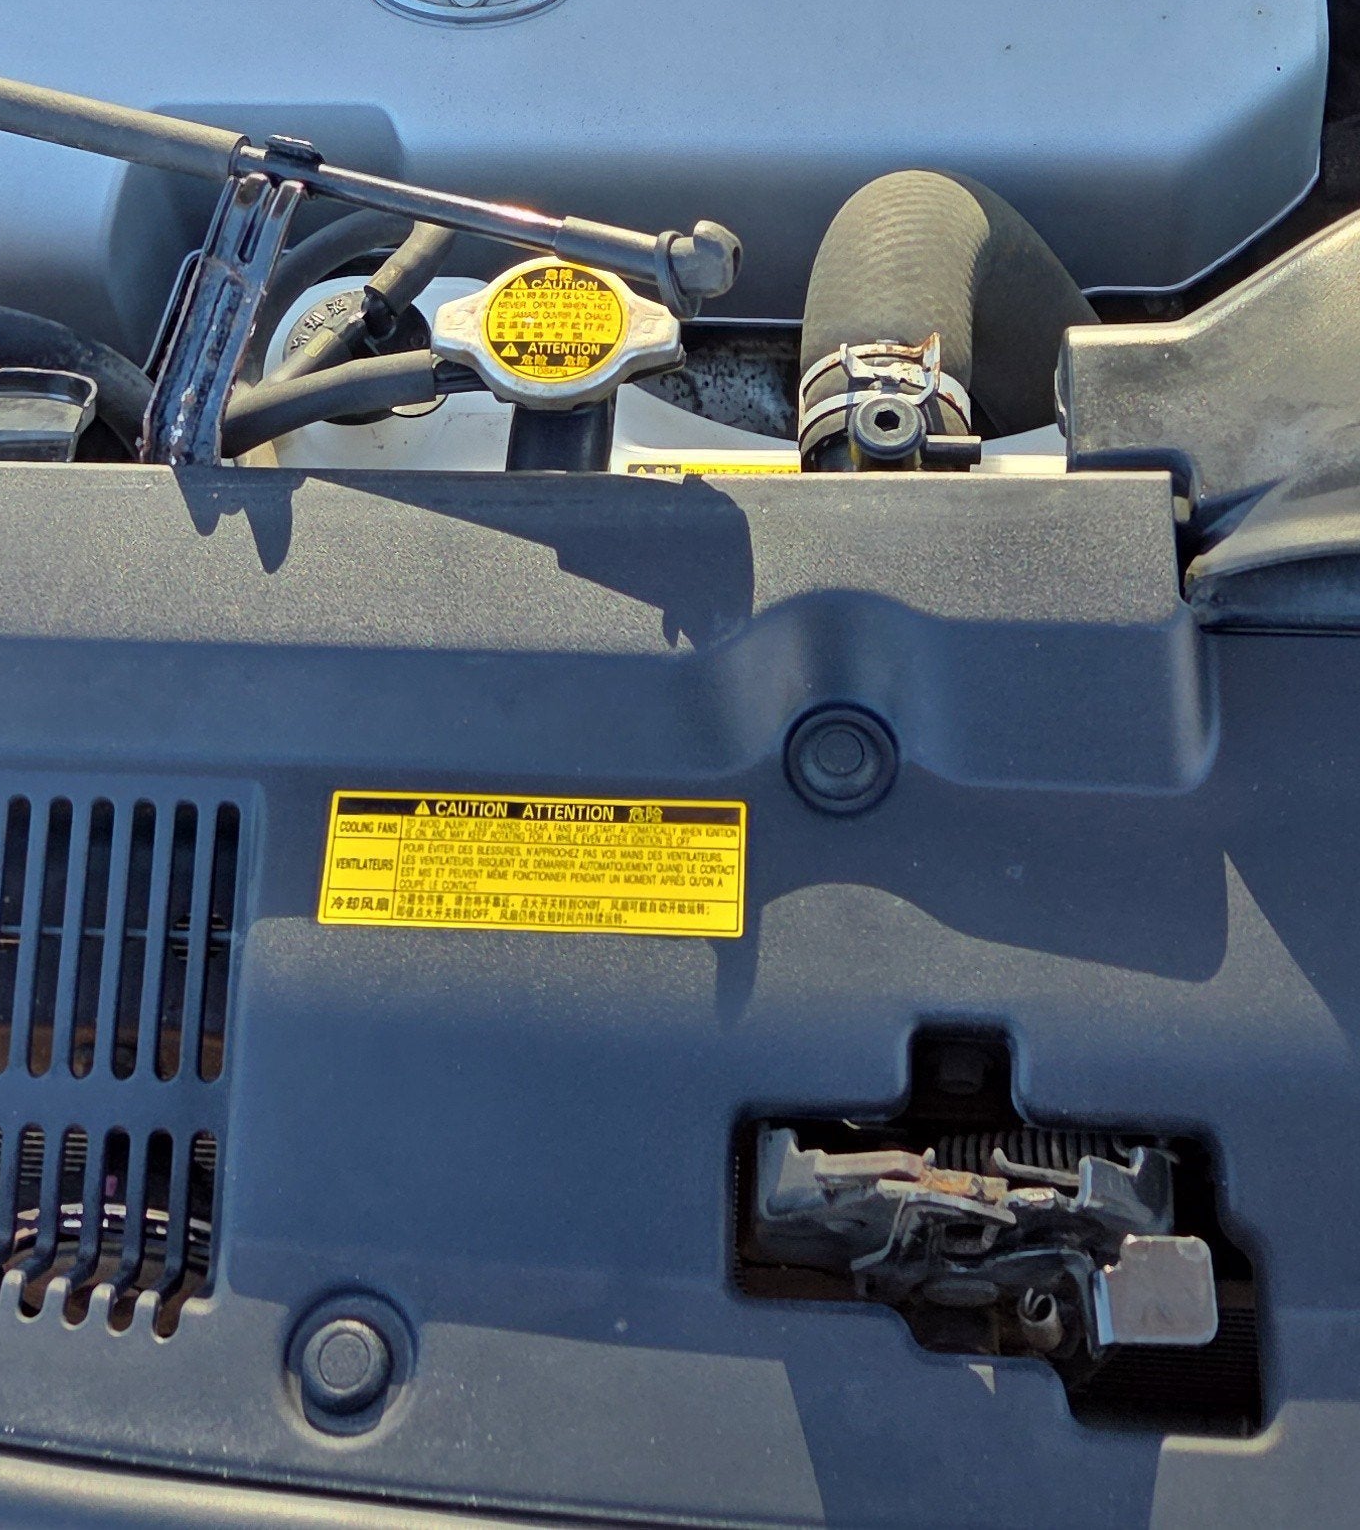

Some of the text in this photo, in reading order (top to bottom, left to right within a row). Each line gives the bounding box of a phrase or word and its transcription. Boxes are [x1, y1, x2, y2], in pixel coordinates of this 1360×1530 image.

[531, 279, 598, 290] CAUTION
[498, 301, 526, 309] NEVER
[562, 302, 587, 310] WHEN
[528, 342, 600, 355] ATTENTION
[435, 802, 508, 818] CAUTION
[522, 804, 614, 821] ATTENTION
[339, 821, 398, 834] COOLING FANS
[681, 828, 701, 836] WHEN
[403, 843, 424, 852] POUR
[458, 845, 472, 854] DES
[583, 849, 597, 858] PAS
[601, 850, 616, 859] VOS
[620, 850, 643, 860] MAINS
[648, 851, 662, 860] DES
[336, 858, 394, 871] VENTILATEURS
[402, 855, 415, 864] LES
[420, 856, 474, 866] VENTILATEURS
[478, 857, 515, 867] RISQUENT
[519, 859, 528, 868] DE
[656, 863, 683, 873] QUAND
[687, 864, 696, 873] LE
[700, 864, 735, 875] CONTACT
[401, 867, 414, 877] EST
[419, 868, 431, 877] MIS
[436, 868, 444, 878] ET
[449, 869, 482, 878] PEUVENT
[513, 871, 566, 882] FONCTIONNER
[570, 872, 605, 882] PENDANT
[610, 873, 620, 883] UN
[624, 874, 656, 885] MOMENT
[690, 876, 713, 887] QU'ON
[430, 880, 437, 889] LE
[331, 896, 389, 911] 冷却风扇
